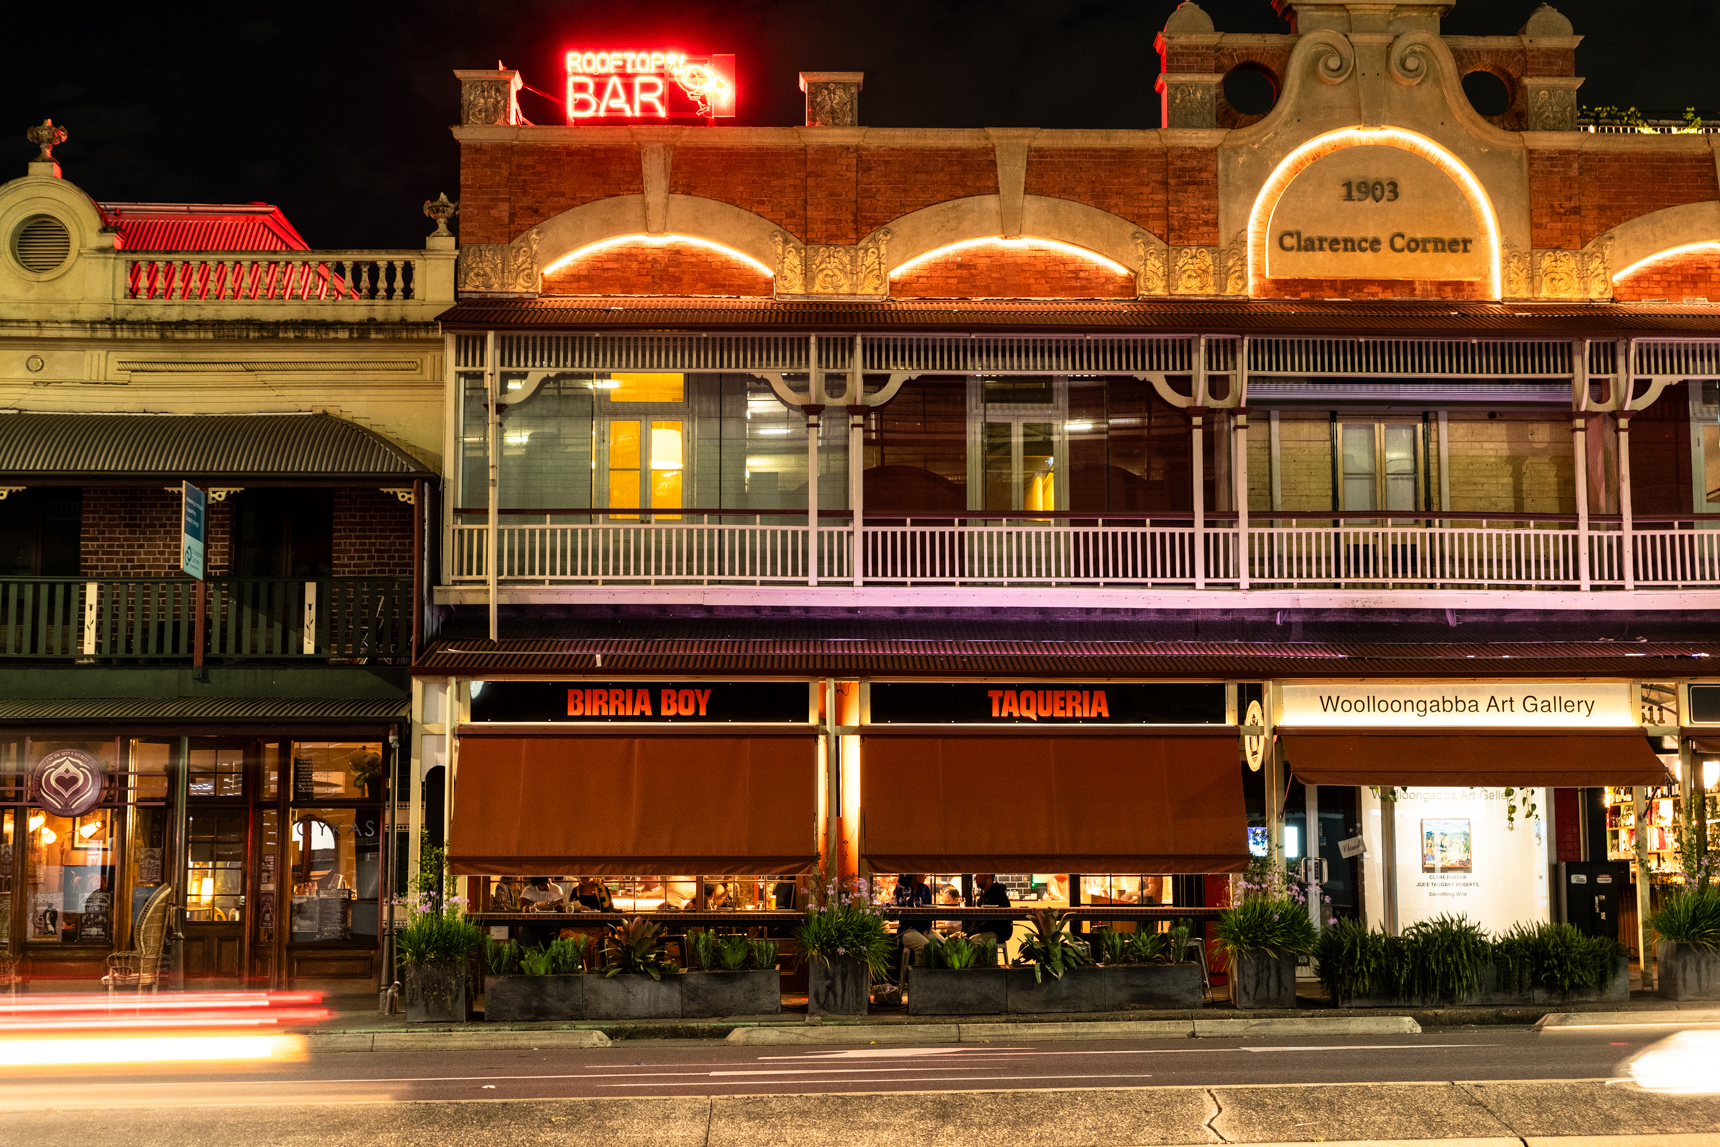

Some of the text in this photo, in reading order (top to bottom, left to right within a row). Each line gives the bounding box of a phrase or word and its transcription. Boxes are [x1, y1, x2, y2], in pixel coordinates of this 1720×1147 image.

[566, 52, 665, 73] ROOFTOP
[566, 75, 667, 118] BAR
[1341, 180, 1400, 202] 1903
[1278, 230, 1473, 254] Clarence Corner
[566, 688, 712, 717] BIRRIA BOY
[987, 689, 1110, 721] TAQUERIA
[1319, 695, 1596, 718] Woolloongabba Art Gallery
[1460, 789, 1476, 800] Art
[1479, 789, 1518, 802] Galley
[296, 819, 375, 838] CYKAS
[1342, 839, 1361, 853] Closed
